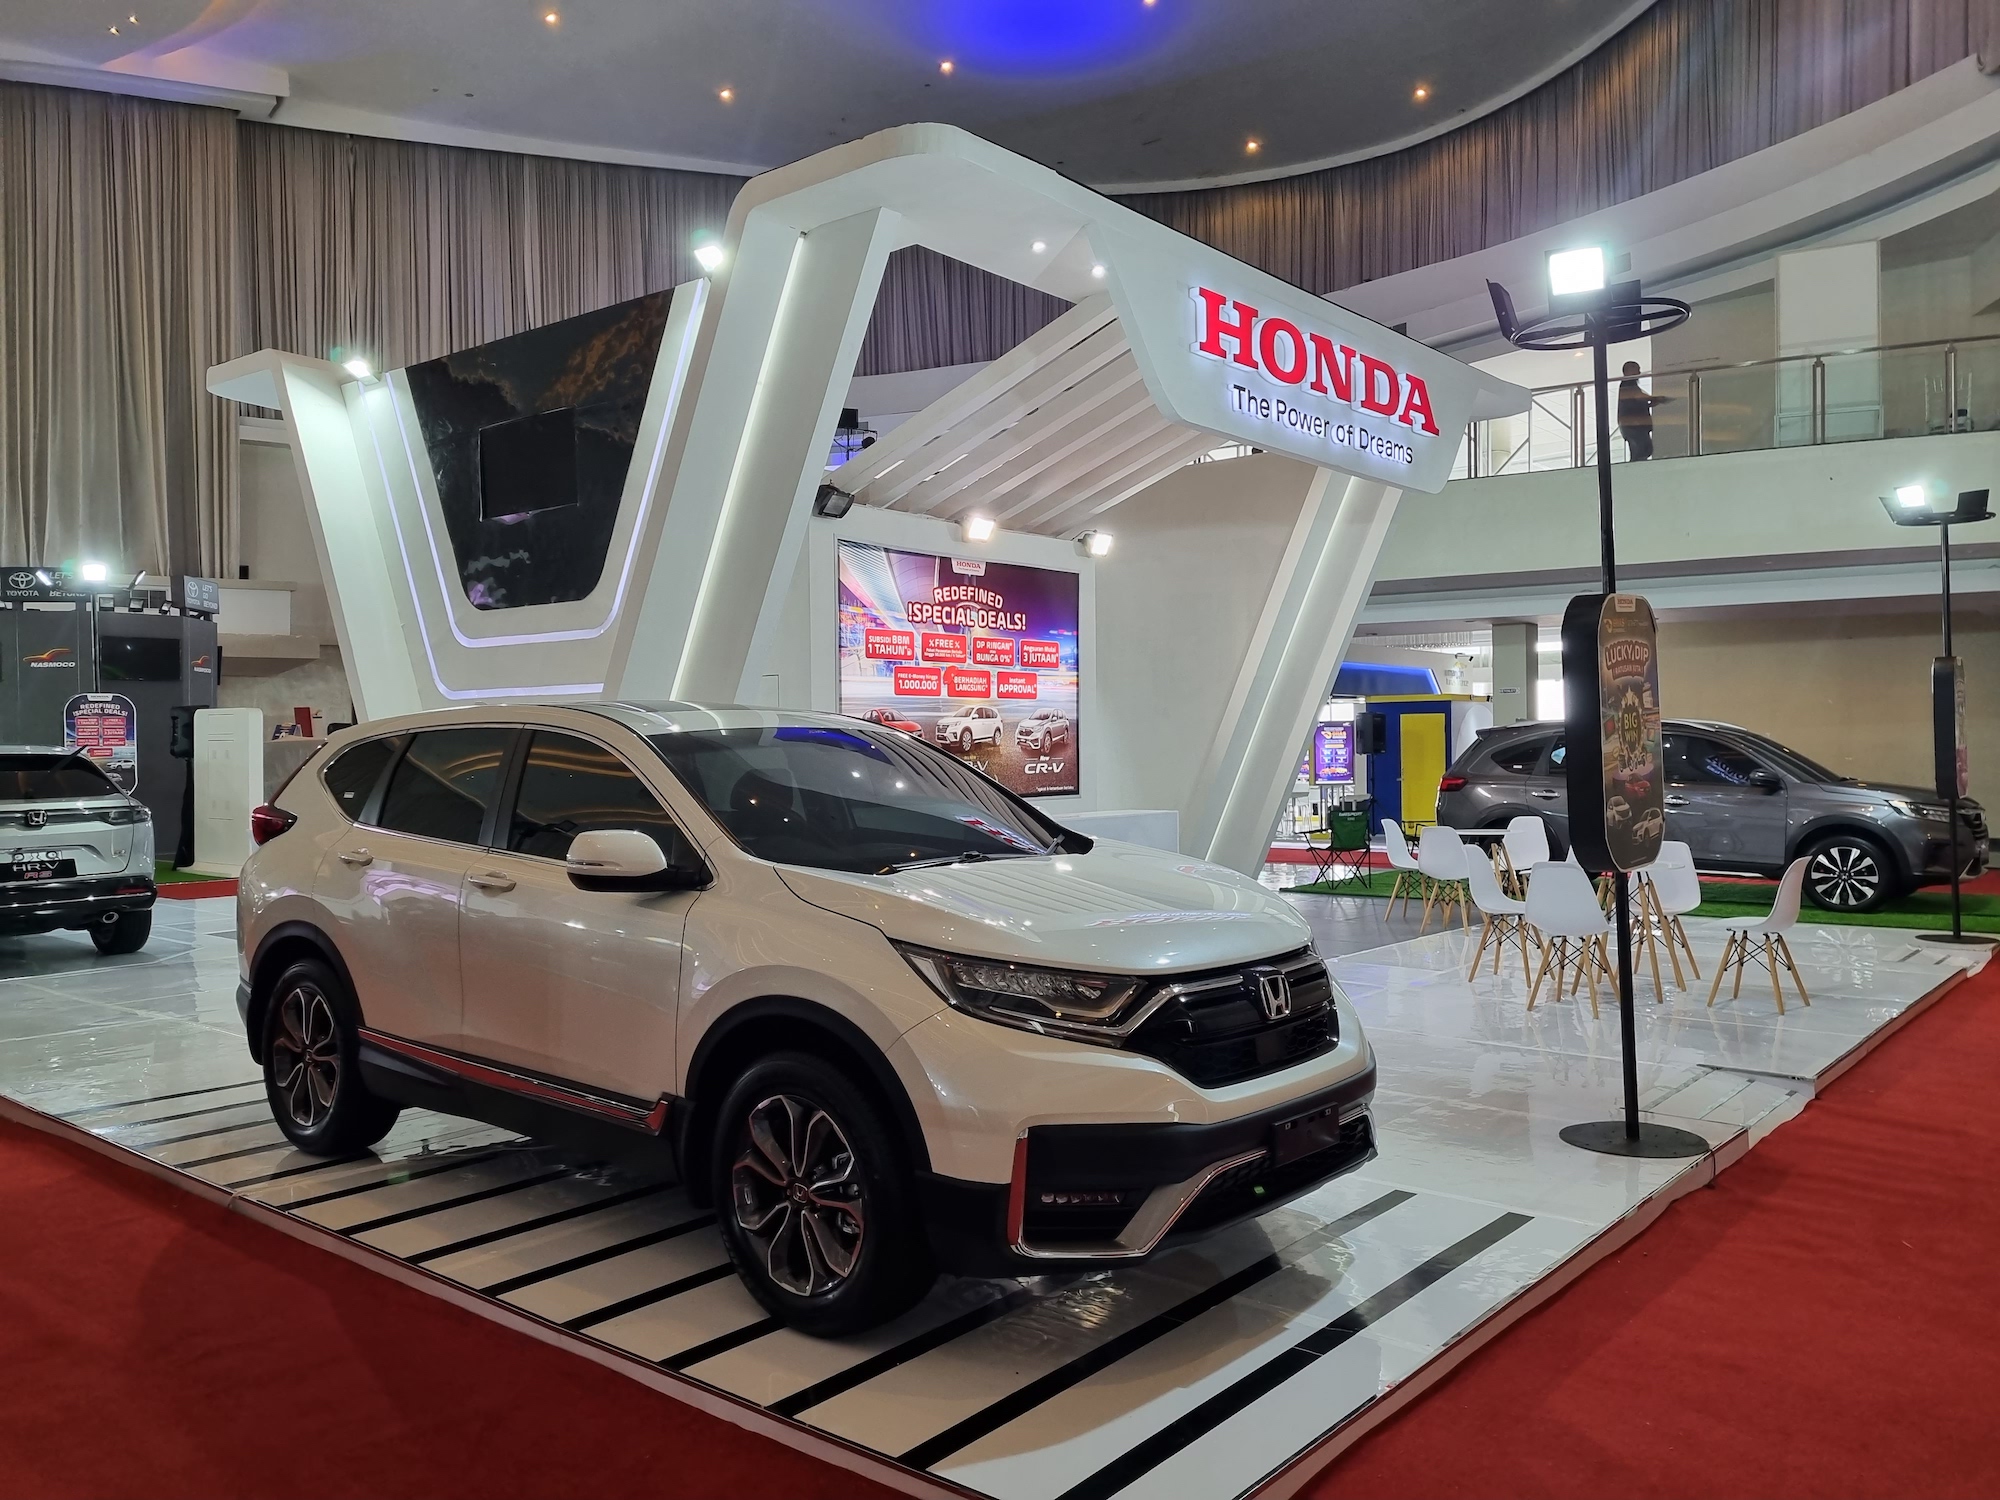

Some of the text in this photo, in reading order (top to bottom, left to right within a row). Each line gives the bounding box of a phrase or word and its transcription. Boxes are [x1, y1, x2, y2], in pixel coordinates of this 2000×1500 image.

[1196, 286, 1440, 437] HONDA
[1232, 384, 1413, 464] The Power of Dreams
[956, 560, 981, 569] HONDA
[933, 586, 1003, 609] REDEFINED
[908, 602, 1026, 630] !SPECIAL DEALS!
[868, 635, 910, 645] SUBSIDI BBM
[935, 638, 954, 648] FREE
[976, 641, 985, 649] DP
[868, 644, 873, 654] 1
[976, 653, 999, 662] BUNGA
[1023, 653, 1028, 662] 3
[1606, 644, 1649, 666] LUCKY DIP
[954, 676, 987, 684] BERHADIAH
[1623, 712, 1638, 730] BIG
[1624, 731, 1638, 742] WIN
[1024, 762, 1065, 774] CR-V
[12, 861, 59, 872] HR-V
[24, 870, 52, 880] RS
